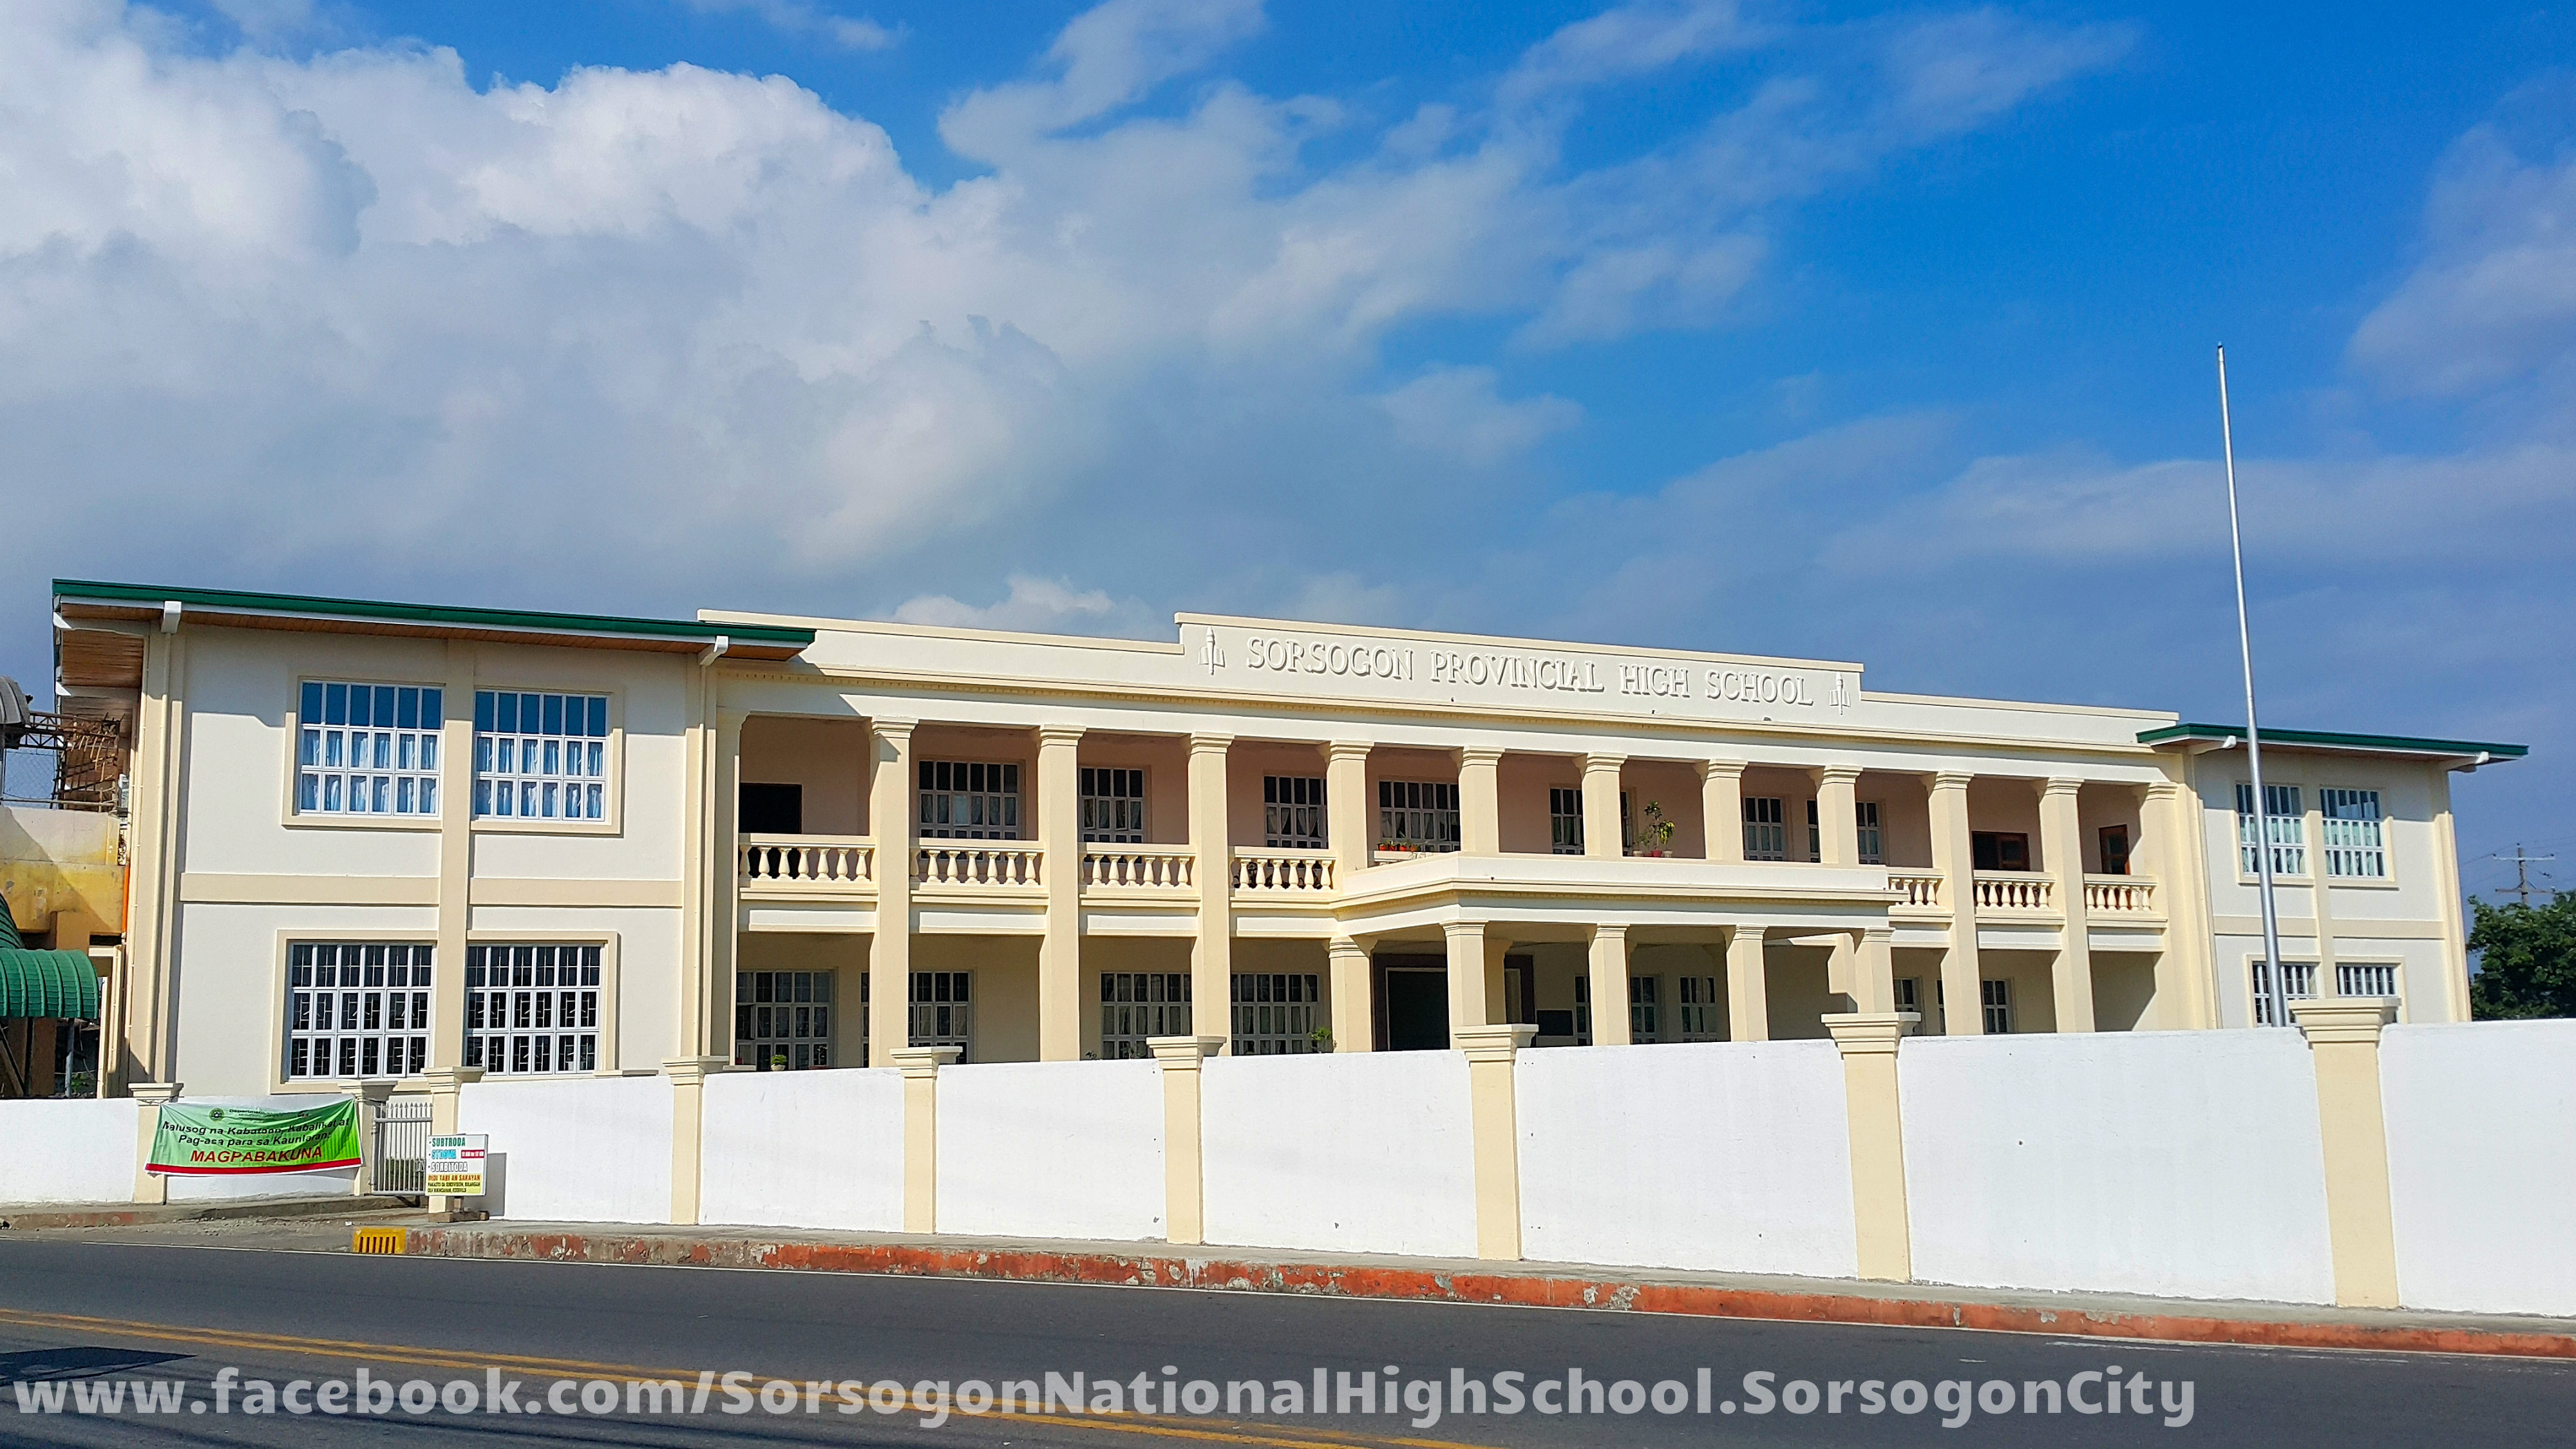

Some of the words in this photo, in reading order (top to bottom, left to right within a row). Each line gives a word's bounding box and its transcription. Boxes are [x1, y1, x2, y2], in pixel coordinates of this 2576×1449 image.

[1247, 637, 1414, 681] SORSOGON
[1430, 649, 1604, 692] PROVINCIAL
[1620, 663, 1690, 697] HIGH
[1705, 670, 1814, 706] SCHOOL
[339, 1118, 348, 1126] at
[178, 1135, 223, 1146] Pag-asa
[227, 1139, 252, 1147] para
[190, 1146, 322, 1163] MAGPABAKUNA
